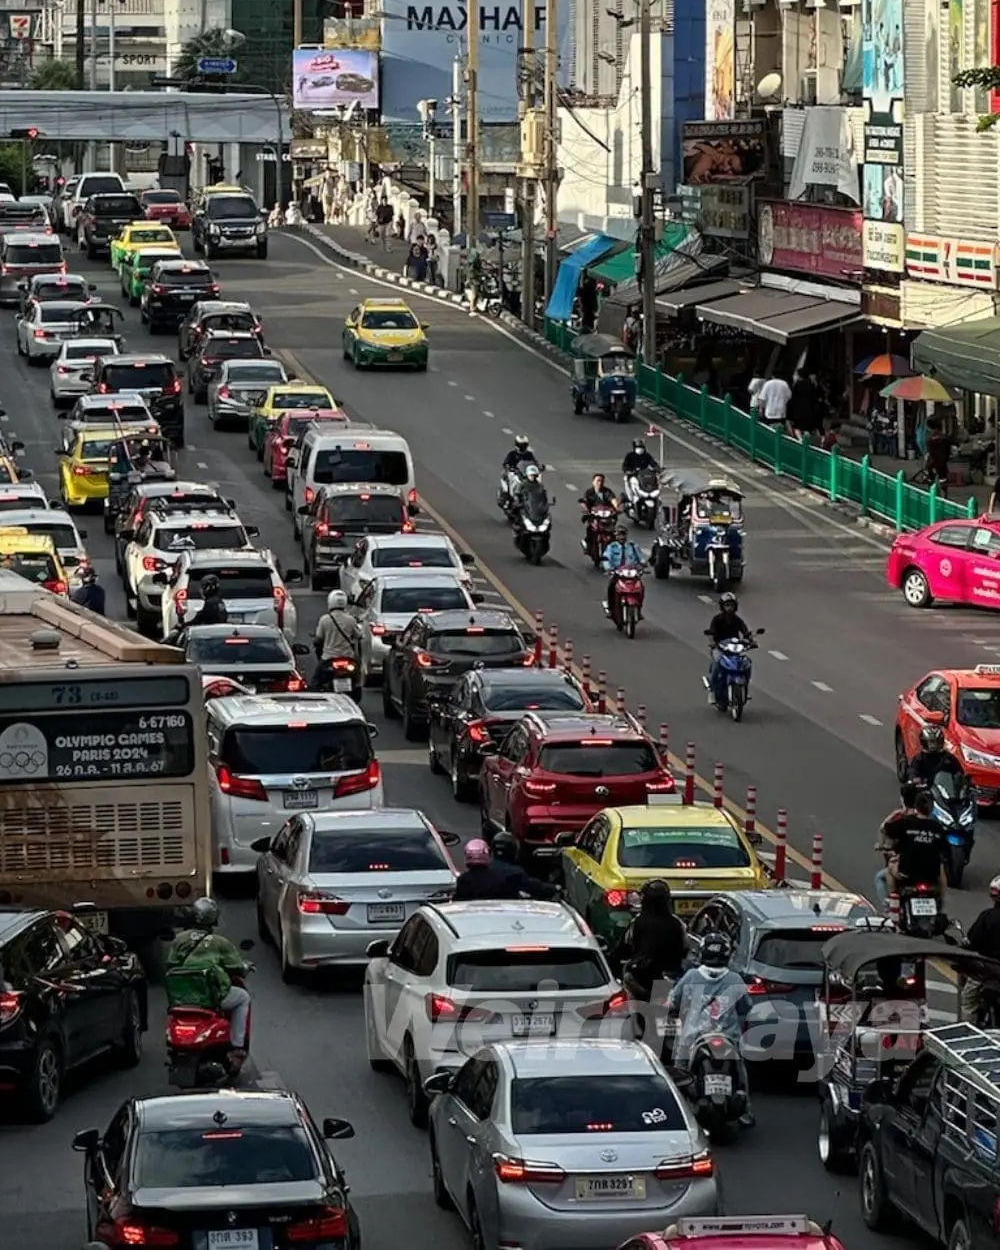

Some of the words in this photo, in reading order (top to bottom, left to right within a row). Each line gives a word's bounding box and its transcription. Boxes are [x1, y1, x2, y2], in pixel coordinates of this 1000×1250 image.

[52, 686, 81, 703] 73
[55, 733, 116, 748] OLYMPIC
[118, 732, 165, 746] GAMES
[72, 749, 112, 762] PARIS
[113, 748, 149, 761] 2024
[56, 766, 72, 776] 26
[150, 762, 164, 773] 67
